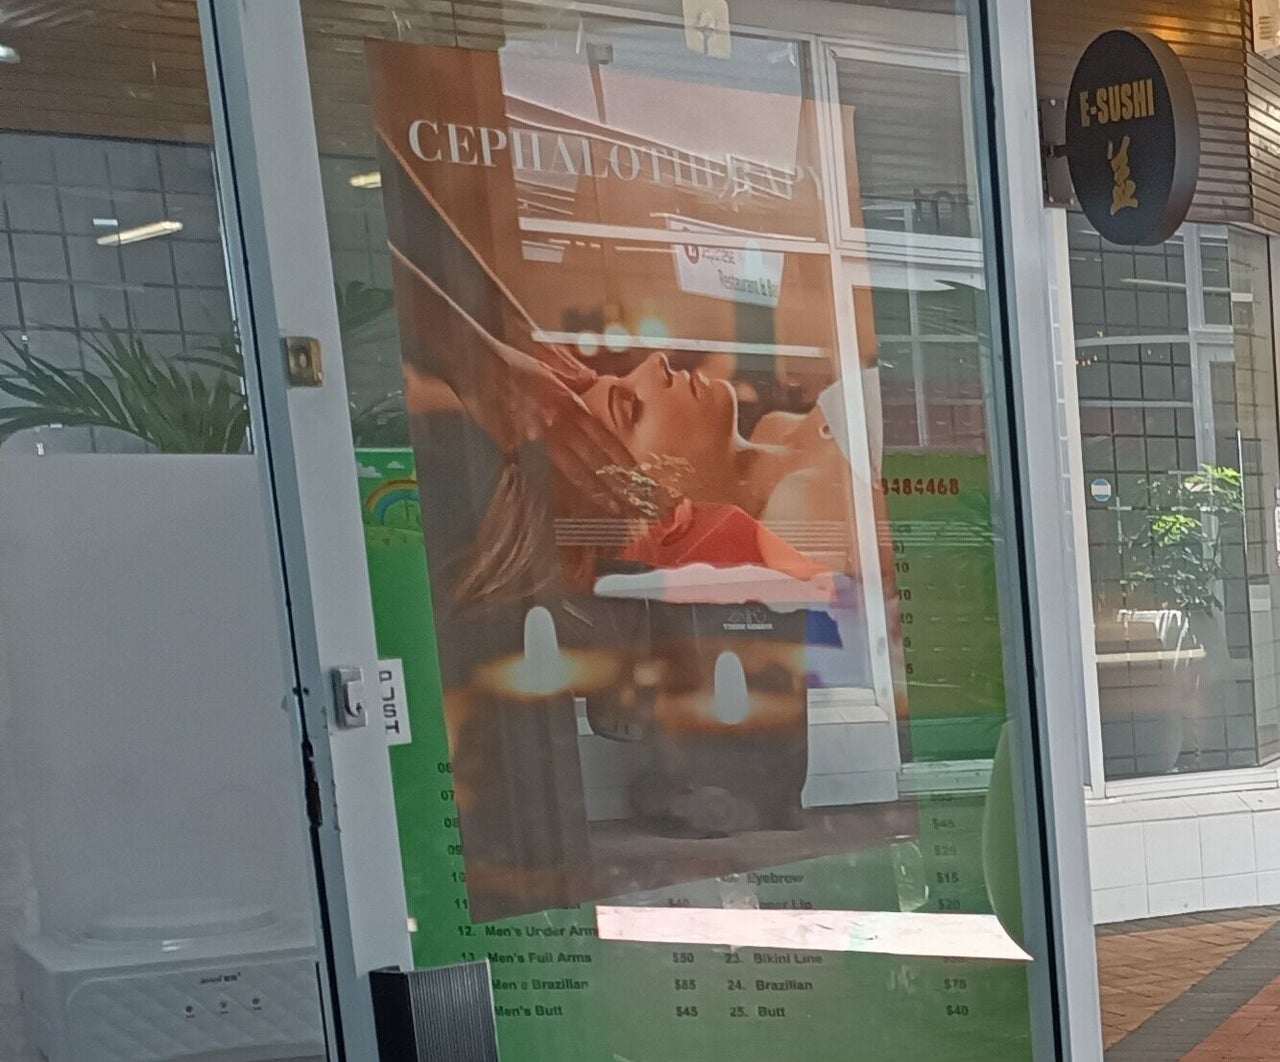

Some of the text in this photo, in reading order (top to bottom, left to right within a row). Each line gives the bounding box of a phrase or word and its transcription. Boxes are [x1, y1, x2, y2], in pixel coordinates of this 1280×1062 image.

[1079, 79, 1154, 127] E-SUSHI
[458, 927, 476, 936] 12.
[488, 953, 592, 963] Men's Full Arms
[674, 980, 696, 990] $85
[756, 980, 813, 991] Brazilian
[535, 1006, 697, 1017] Butt $45
[758, 1005, 969, 1017] Butt $40
